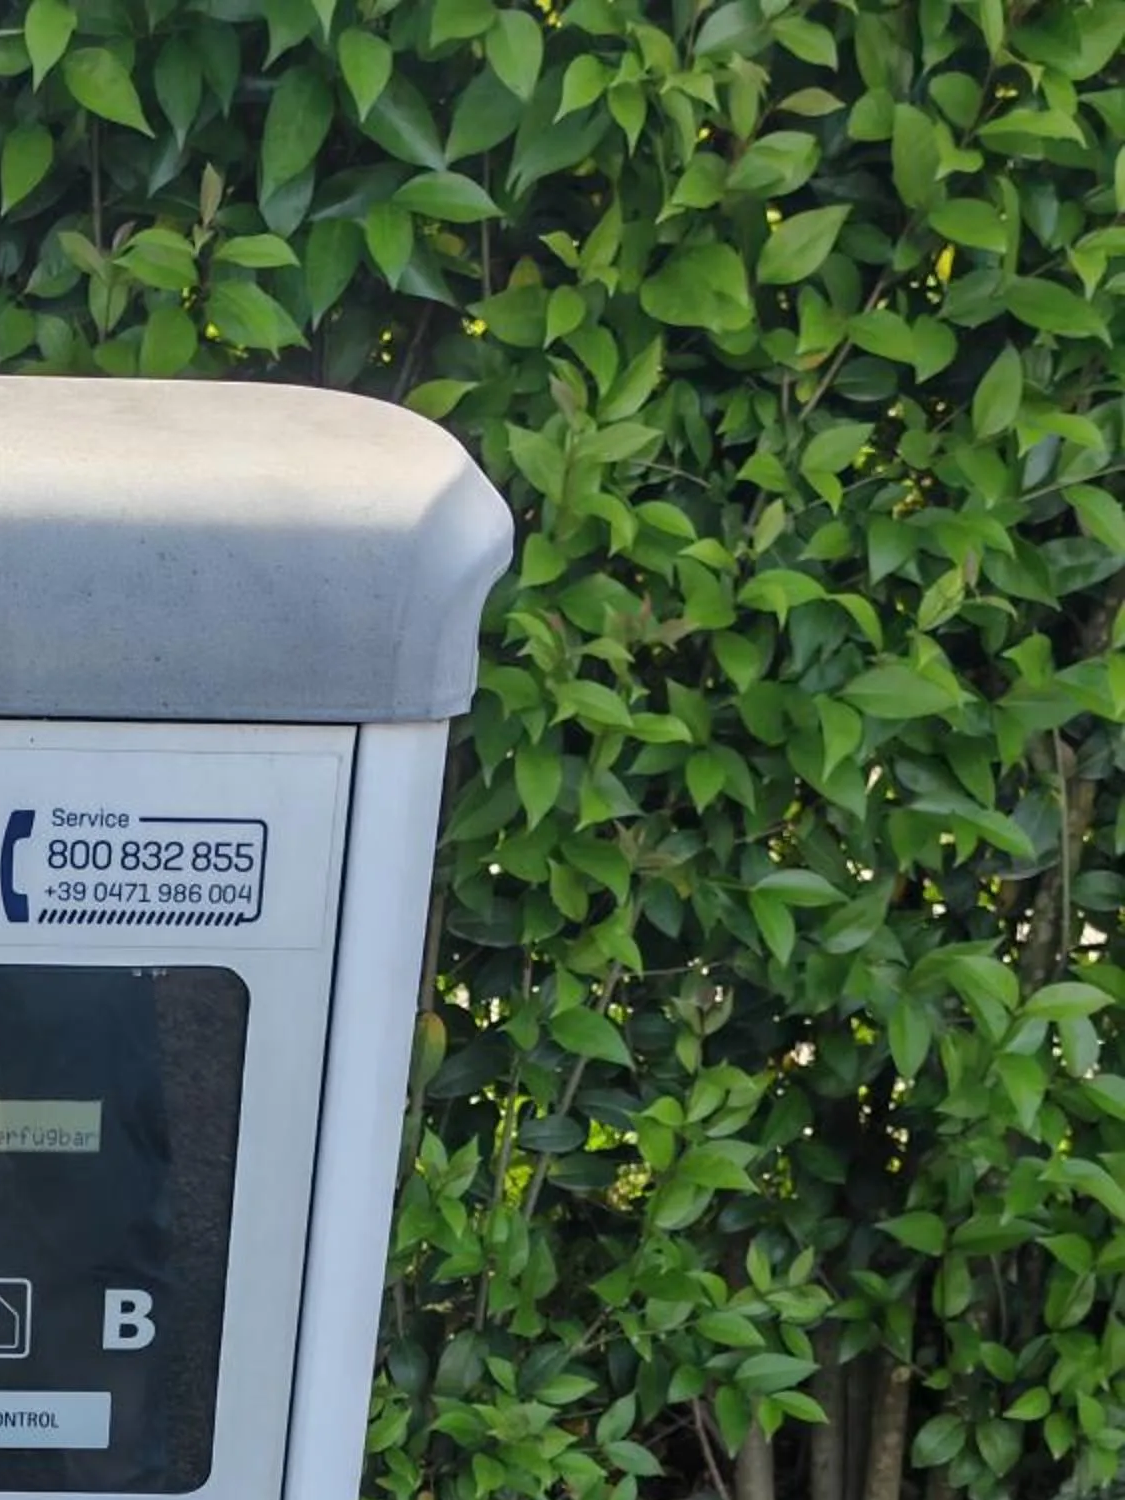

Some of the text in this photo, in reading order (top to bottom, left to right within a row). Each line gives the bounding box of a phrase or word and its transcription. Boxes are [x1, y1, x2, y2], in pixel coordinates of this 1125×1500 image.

[51, 807, 130, 828] Service
[47, 839, 255, 872] 800 832 855
[45, 881, 252, 904] +39 0471 986 004
[102, 1288, 156, 1350] B
